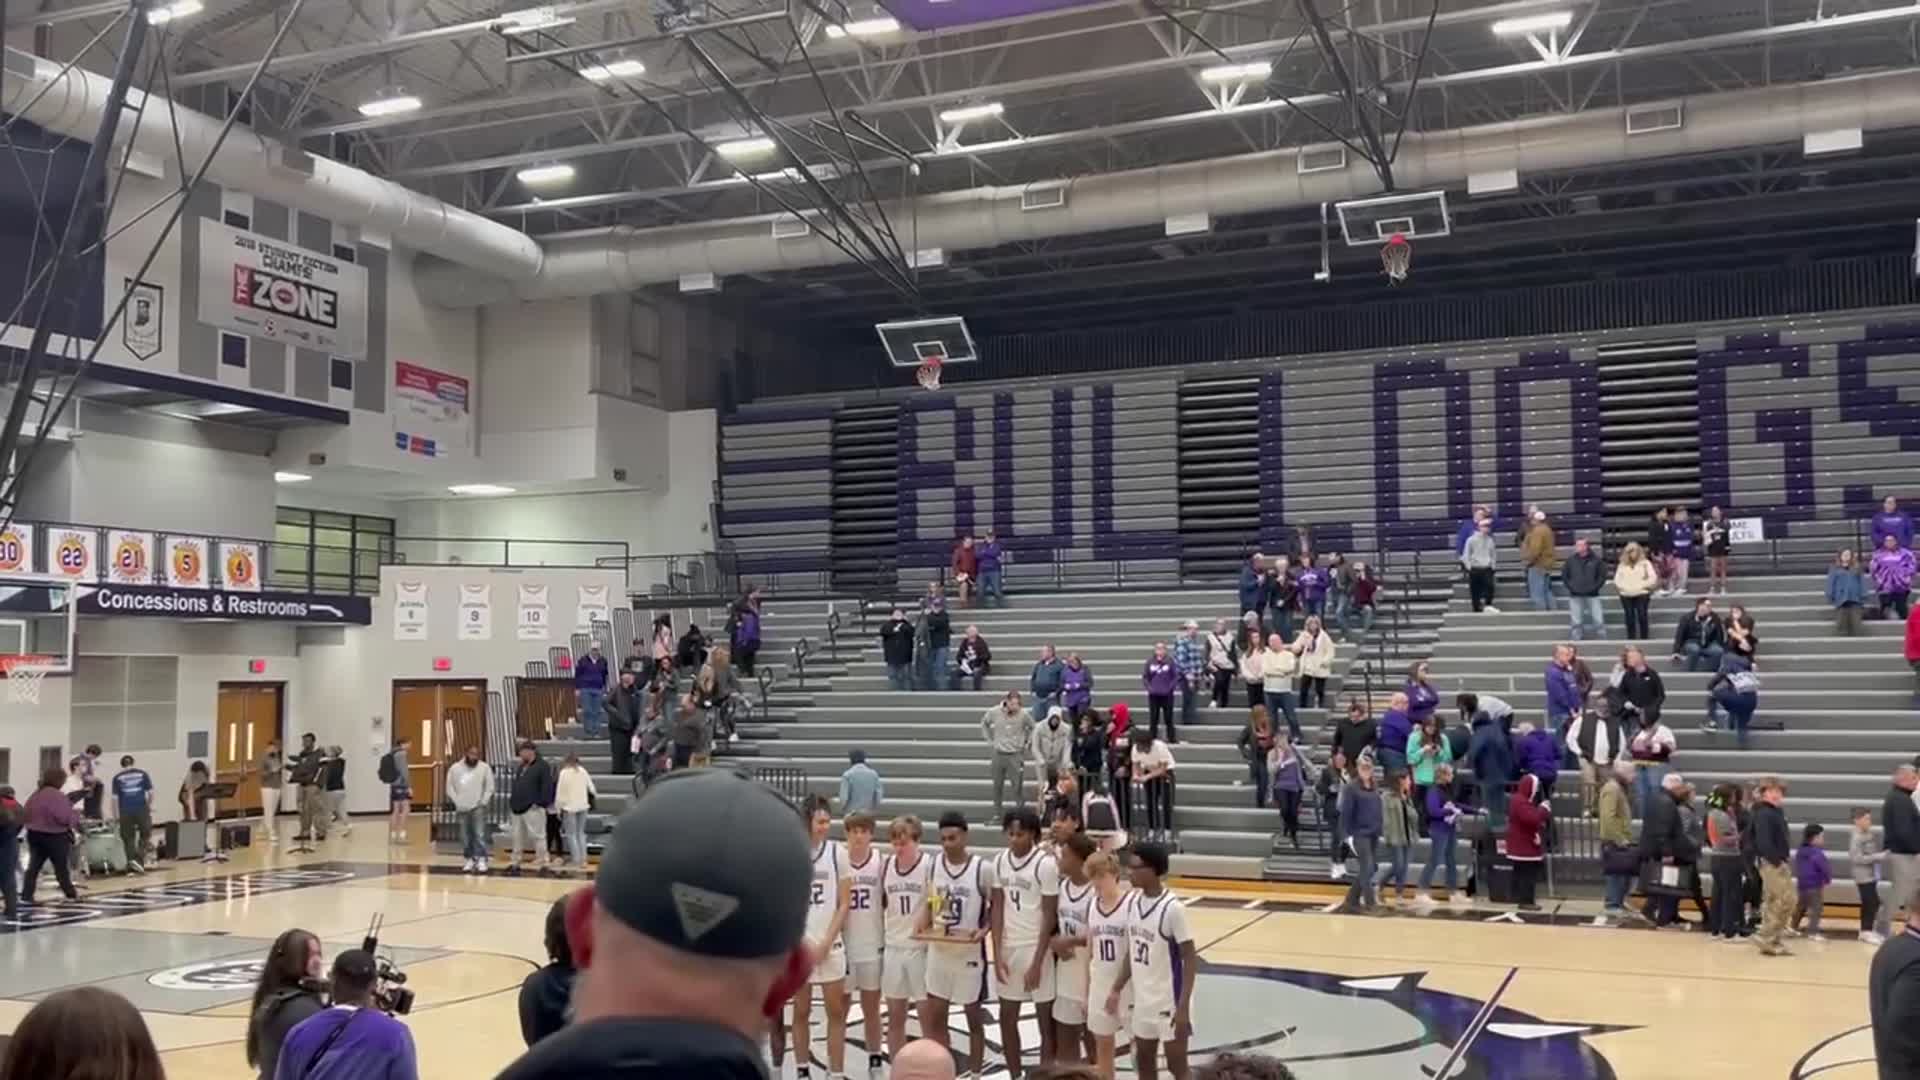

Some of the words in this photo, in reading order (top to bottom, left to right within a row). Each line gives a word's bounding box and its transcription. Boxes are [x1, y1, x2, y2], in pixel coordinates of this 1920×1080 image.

[253, 272, 336, 326] ZONE
[62, 546, 82, 567] 22
[122, 548, 139, 569] 21
[183, 554, 192, 573] 5
[98, 588, 208, 613] Concessions
[212, 594, 224, 613] &
[228, 595, 308, 617] Restrooms
[526, 611, 541, 622] 10
[849, 888, 870, 910] 32
[900, 895, 910, 915] 11
[1010, 890, 1021, 912] 4
[1100, 939, 1115, 961] 10
